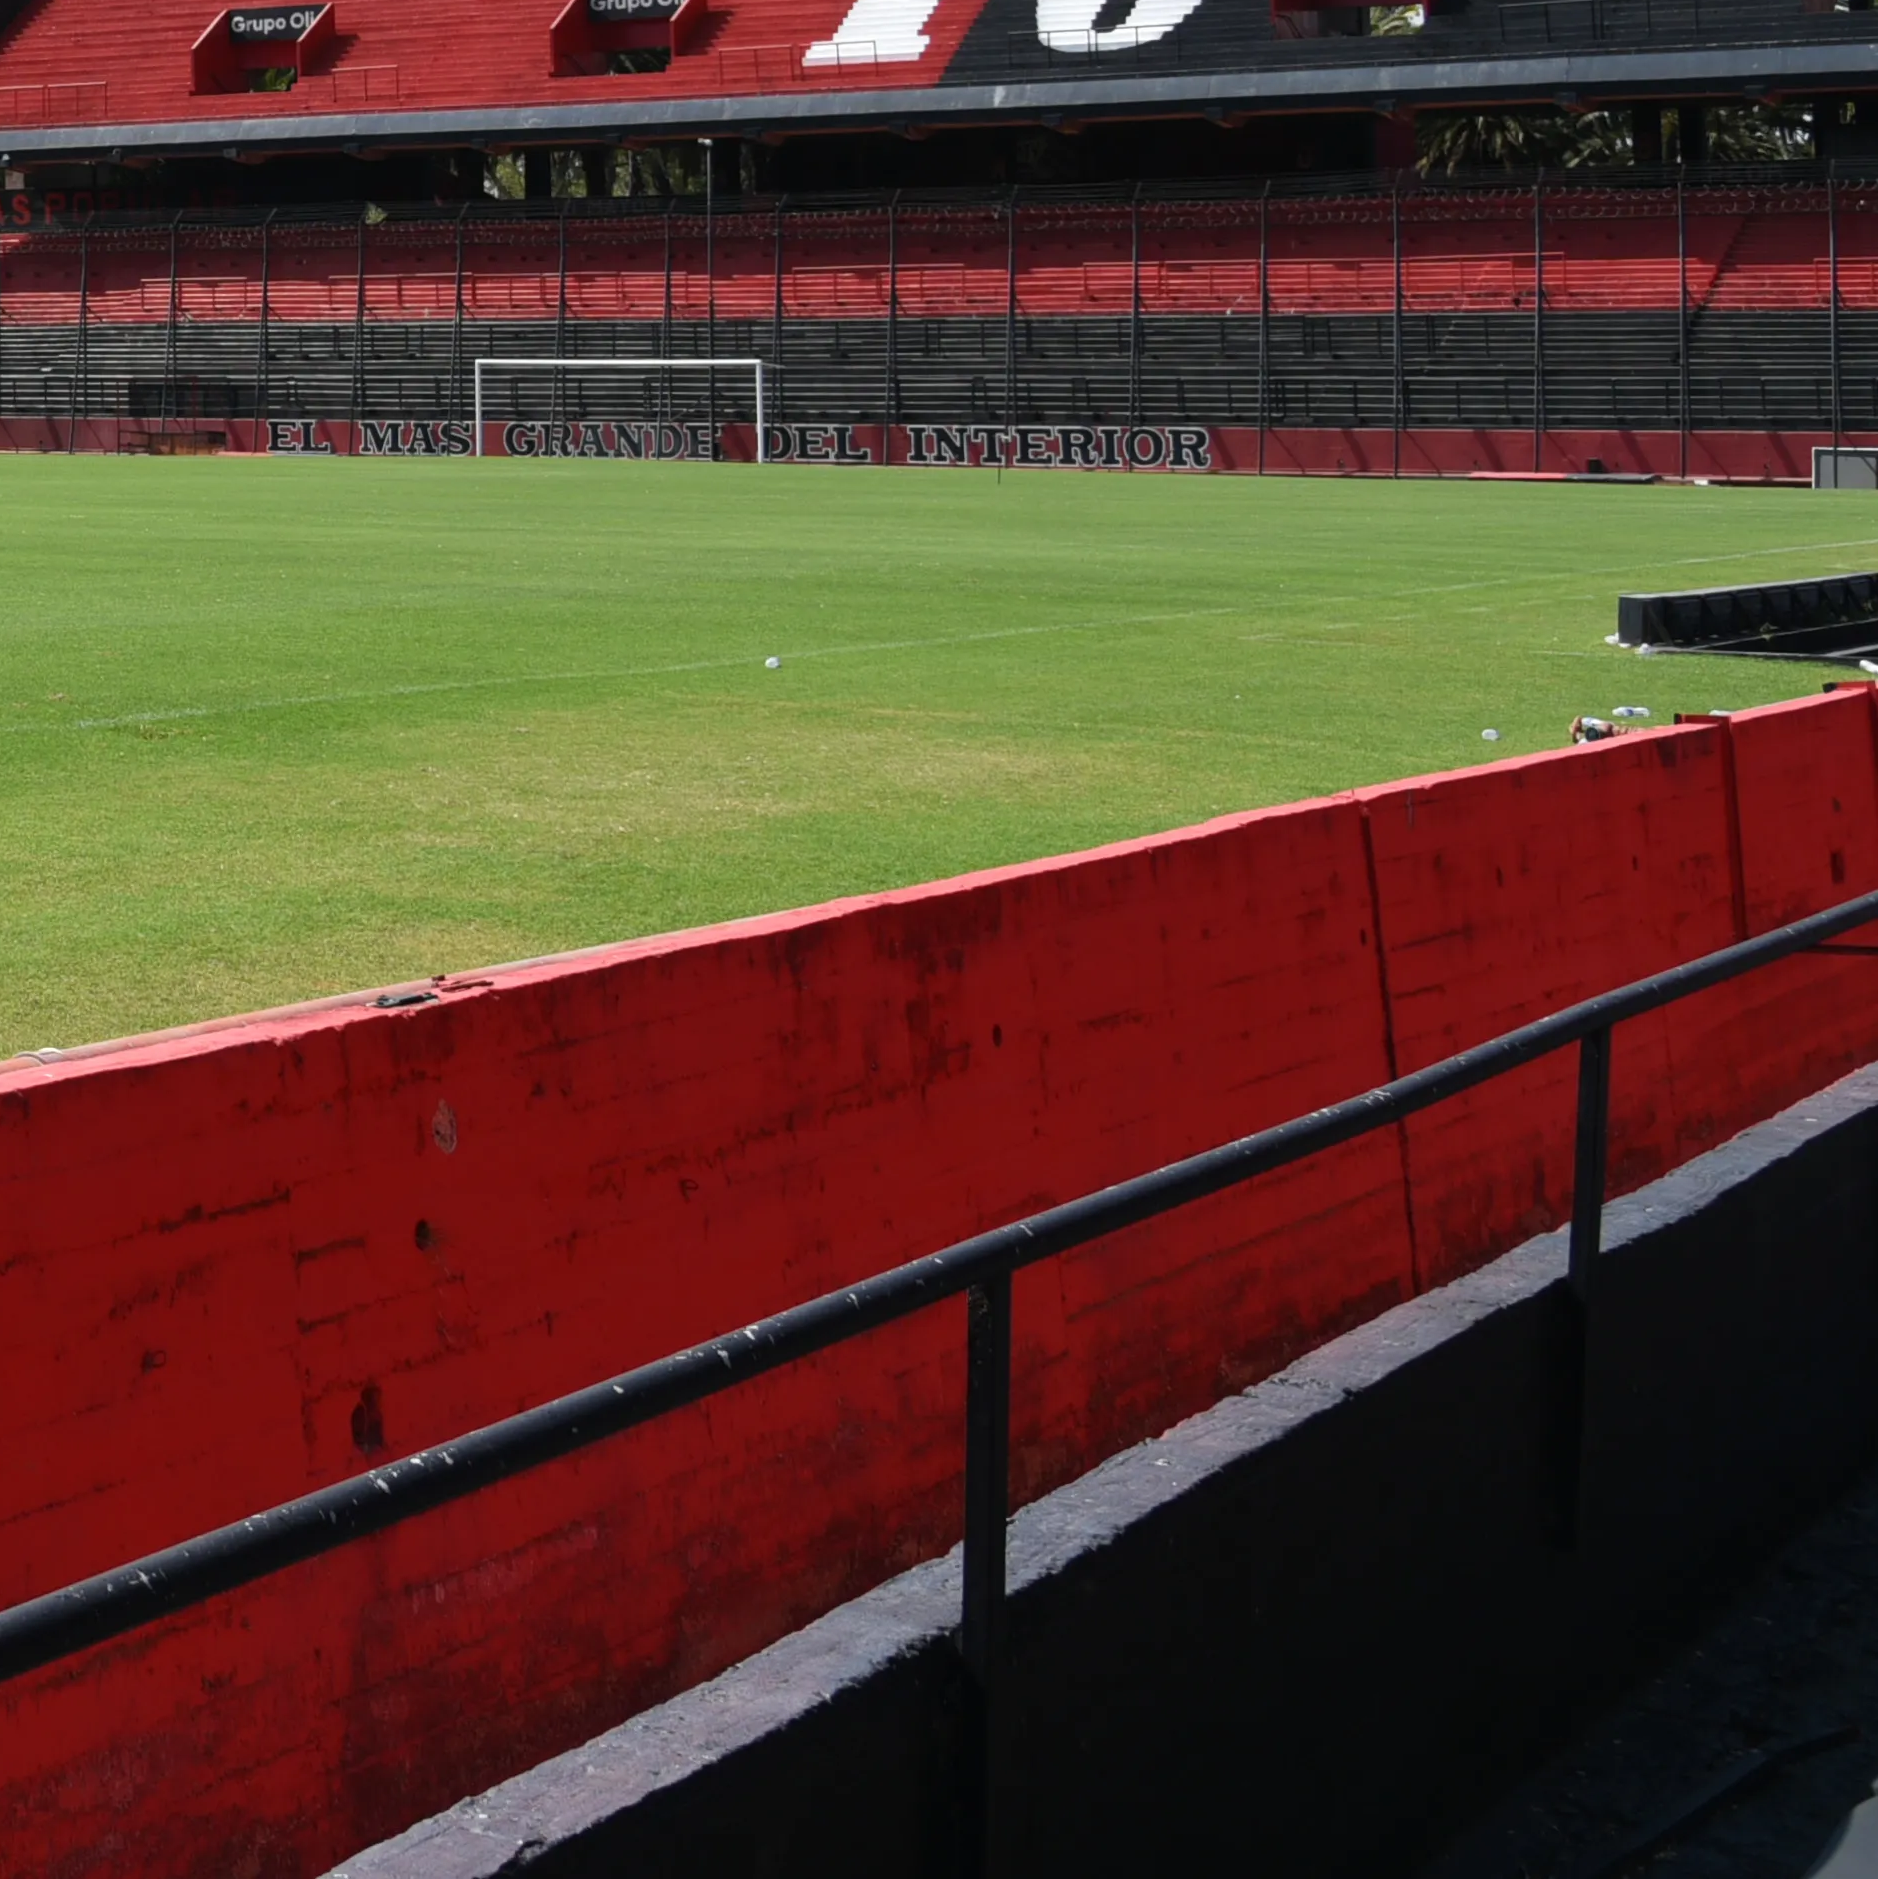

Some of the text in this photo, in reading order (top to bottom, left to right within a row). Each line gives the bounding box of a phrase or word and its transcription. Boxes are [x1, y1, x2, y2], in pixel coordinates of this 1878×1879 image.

[231, 15, 286, 35] Grupo
[266, 419, 1212, 470] EL MAS GRANDE DEL INTERIOR
